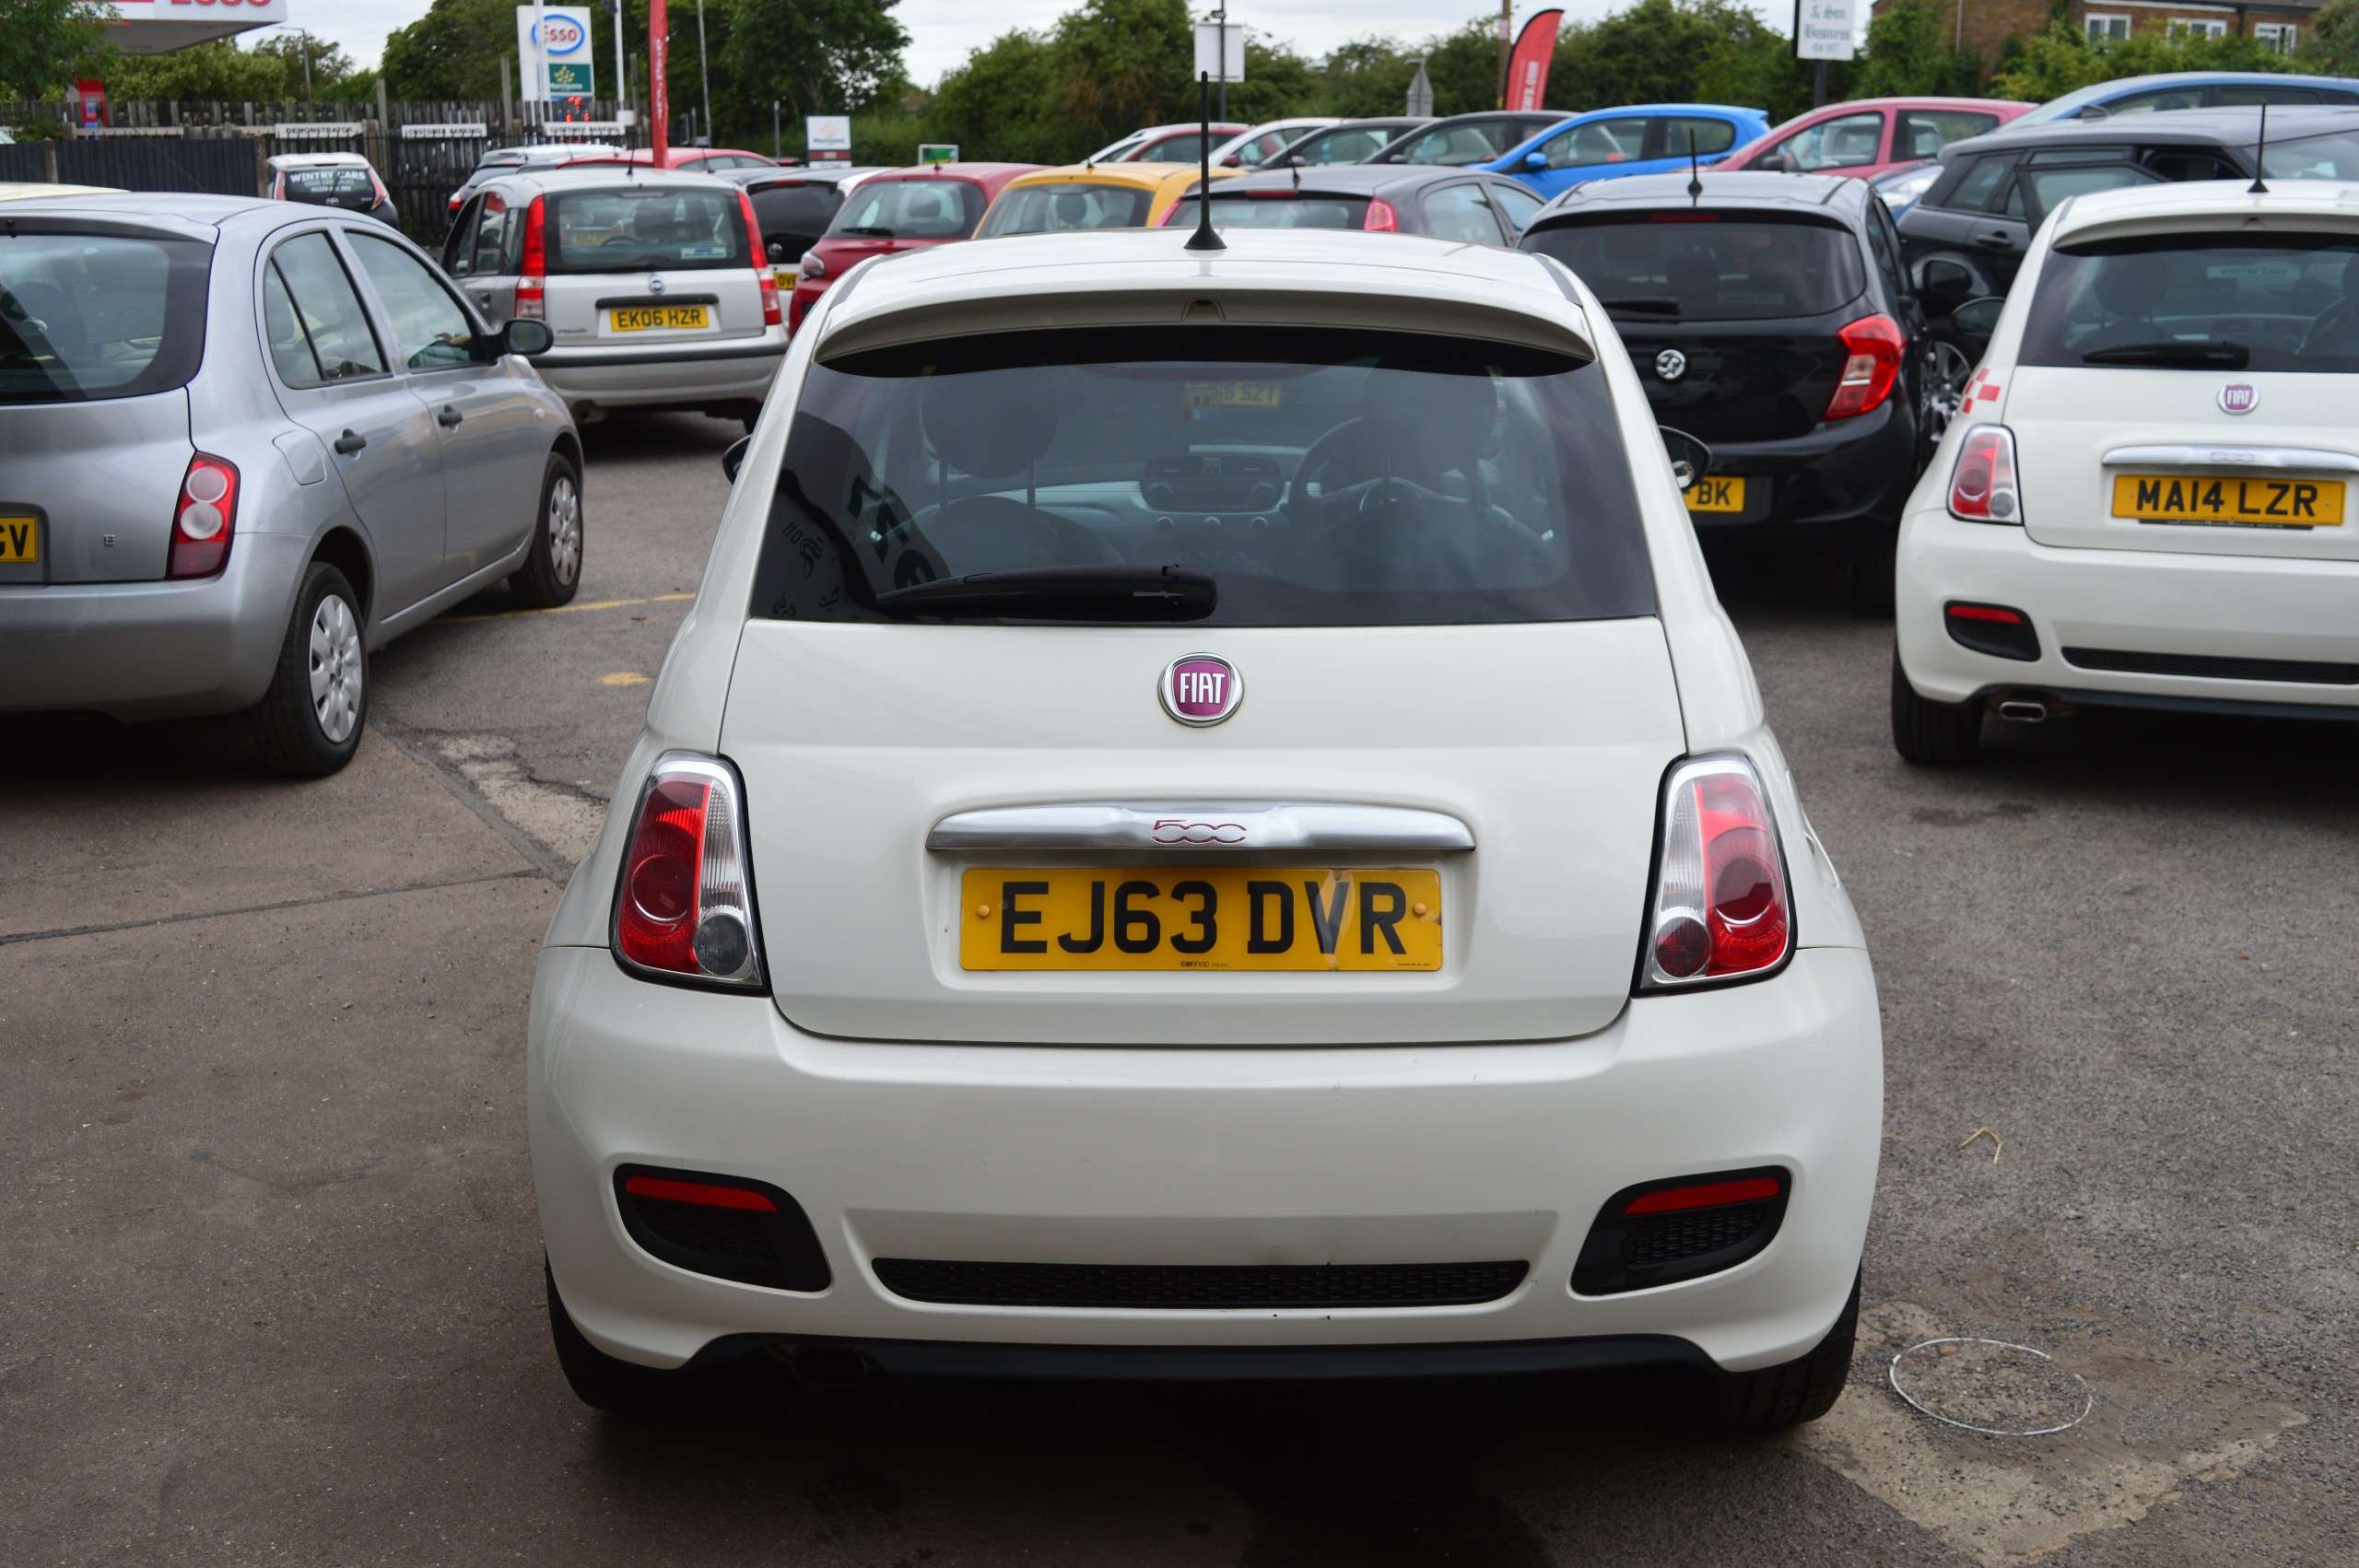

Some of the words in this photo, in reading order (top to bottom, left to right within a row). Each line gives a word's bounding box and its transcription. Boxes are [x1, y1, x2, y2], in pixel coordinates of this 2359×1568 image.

[618, 311, 663, 328] EK06
[667, 309, 701, 325] HZR
[2226, 390, 2250, 405] FIAT
[2136, 479, 2224, 513] MA14
[2238, 482, 2318, 517] LZR
[1180, 673, 1226, 704] FIAT
[1152, 819, 1247, 844] 500
[1001, 880, 1218, 954] EJ63
[1247, 881, 1408, 955] DVR
